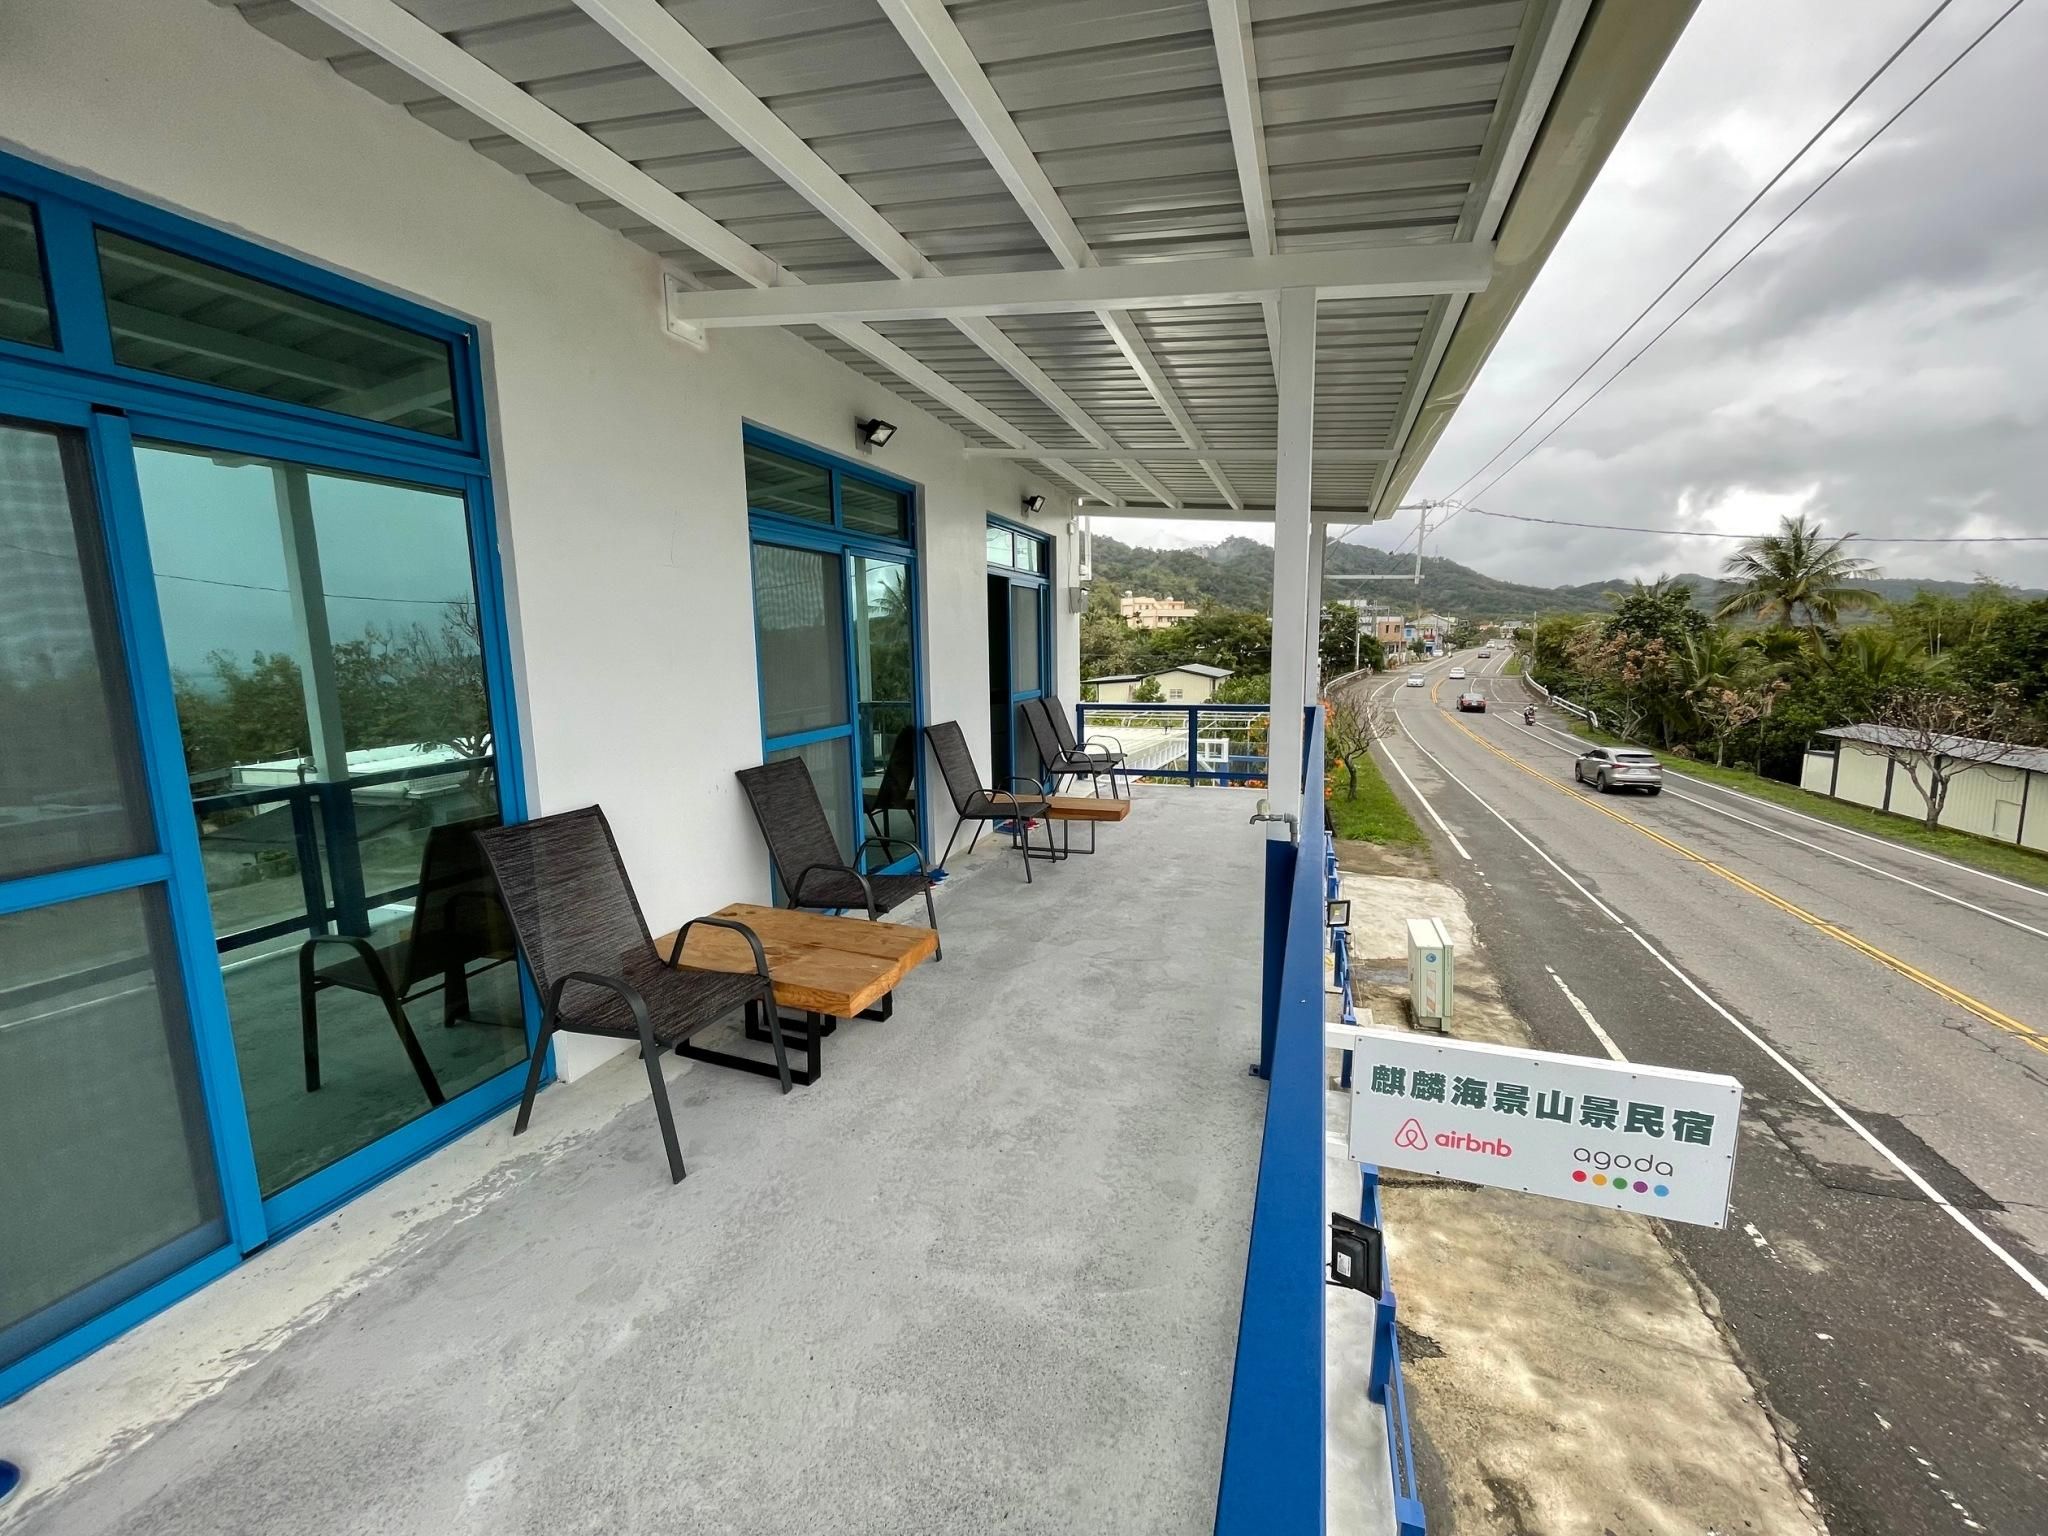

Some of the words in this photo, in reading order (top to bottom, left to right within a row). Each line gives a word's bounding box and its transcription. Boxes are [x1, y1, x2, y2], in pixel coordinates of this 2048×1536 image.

[1371, 1065, 1715, 1146] 麒麟海景山景民宿
[1435, 1130, 1512, 1157] airbnb
[1573, 1147, 1673, 1177] agoda
